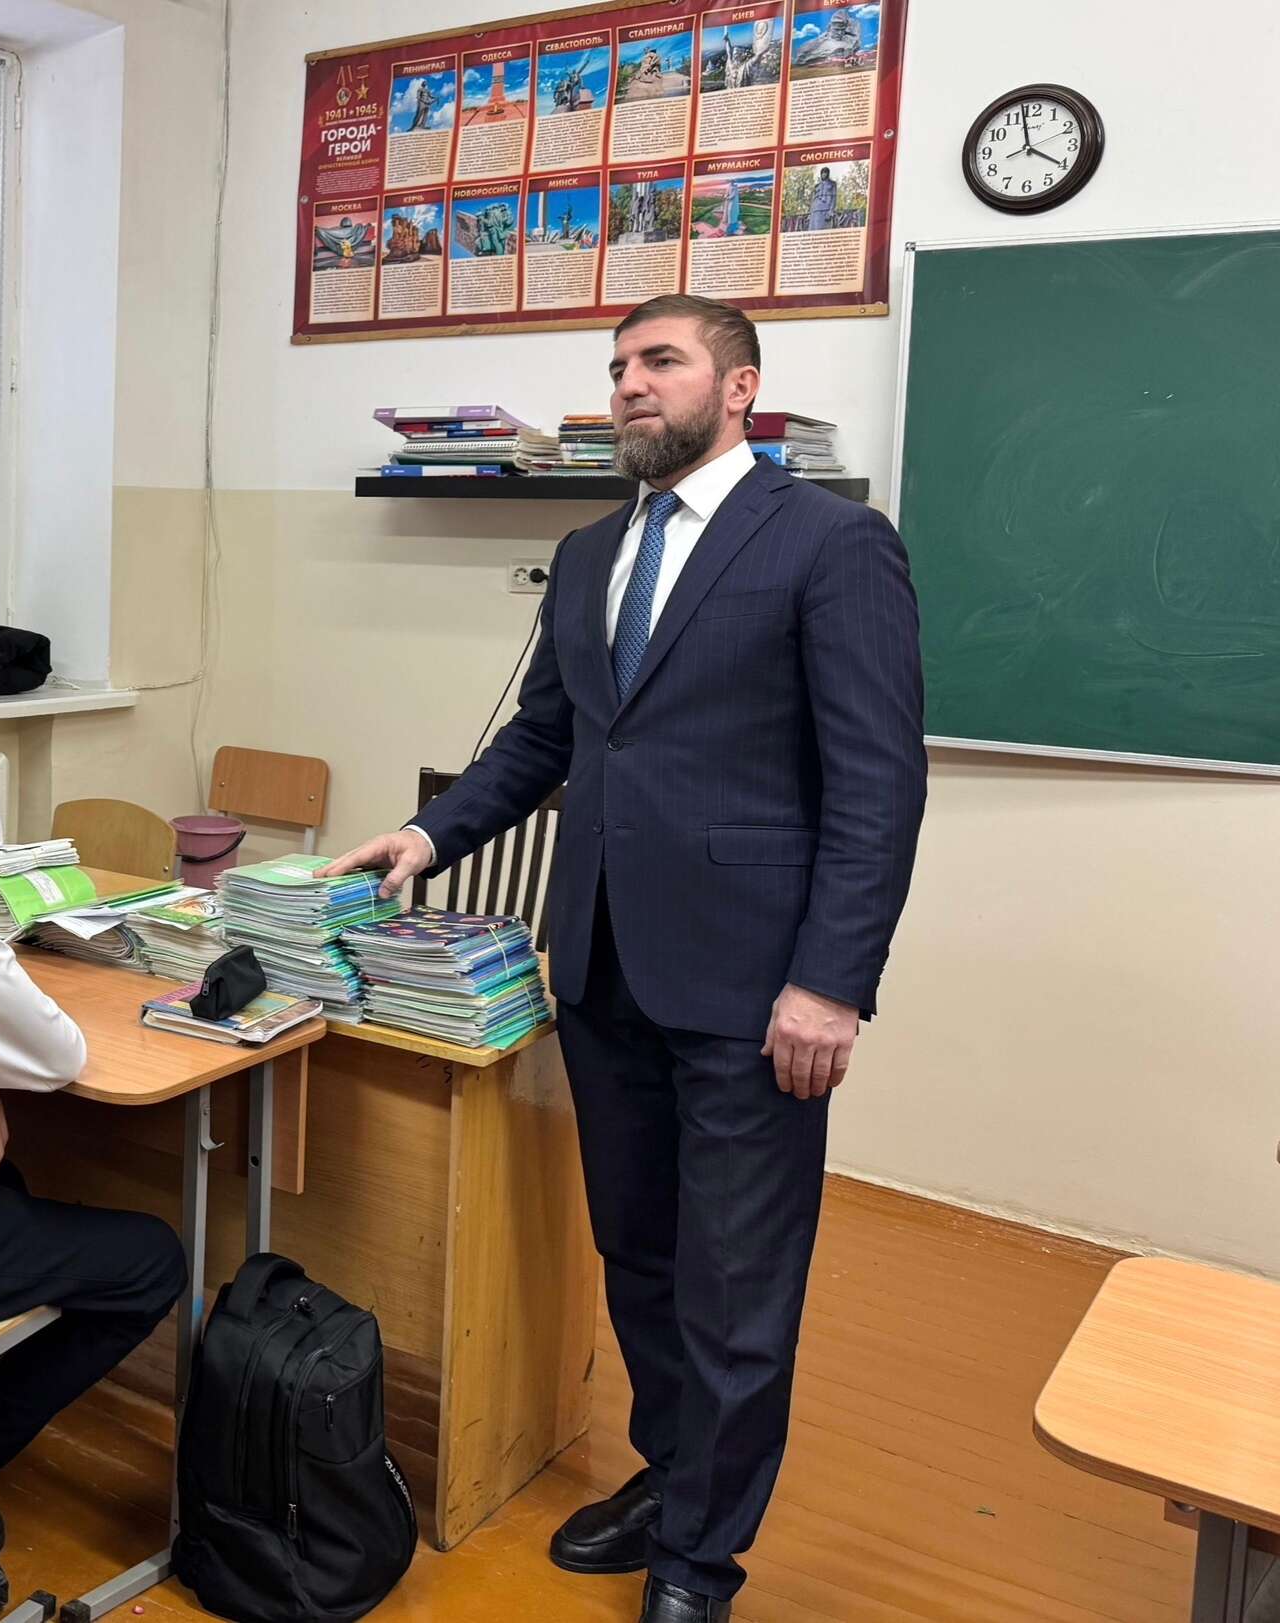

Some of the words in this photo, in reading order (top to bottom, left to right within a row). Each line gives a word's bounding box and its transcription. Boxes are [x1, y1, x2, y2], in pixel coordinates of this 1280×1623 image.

[732, 10, 754, 22] КИЕВ
[628, 22, 685, 39] СТАЛИНГРАД
[544, 36, 603, 52] СЕВАСТОПОЛЬ
[481, 50, 512, 62] ОДЕССА
[402, 61, 446, 74] ЛЕНИНГРАД
[325, 108, 347, 121] 1941
[356, 103, 378, 117] 1945
[1024, 104, 1042, 118] 12
[1050, 108, 1058, 122] 1
[1004, 111, 1021, 126] 11
[321, 123, 382, 143] ГОРОДА-
[1062, 120, 1074, 134] 2
[989, 128, 1007, 142] 10
[328, 139, 371, 156] ГЕРОИ
[1067, 138, 1078, 152] 3
[800, 149, 854, 162] СМОЛЕНСК
[982, 146, 992, 160] 9
[707, 158, 761, 172] МУРМАНСК
[987, 164, 997, 176] 8
[1058, 157, 1068, 170] 4
[637, 170, 659, 179] ТУЛА
[1044, 173, 1054, 186] 5
[548, 178, 578, 188] МИНСК
[1002, 176, 1012, 190] 7
[1022, 180, 1032, 193] 6
[454, 184, 518, 198] НОВОРОССИЙСК
[331, 203, 362, 212] МОСКВА
